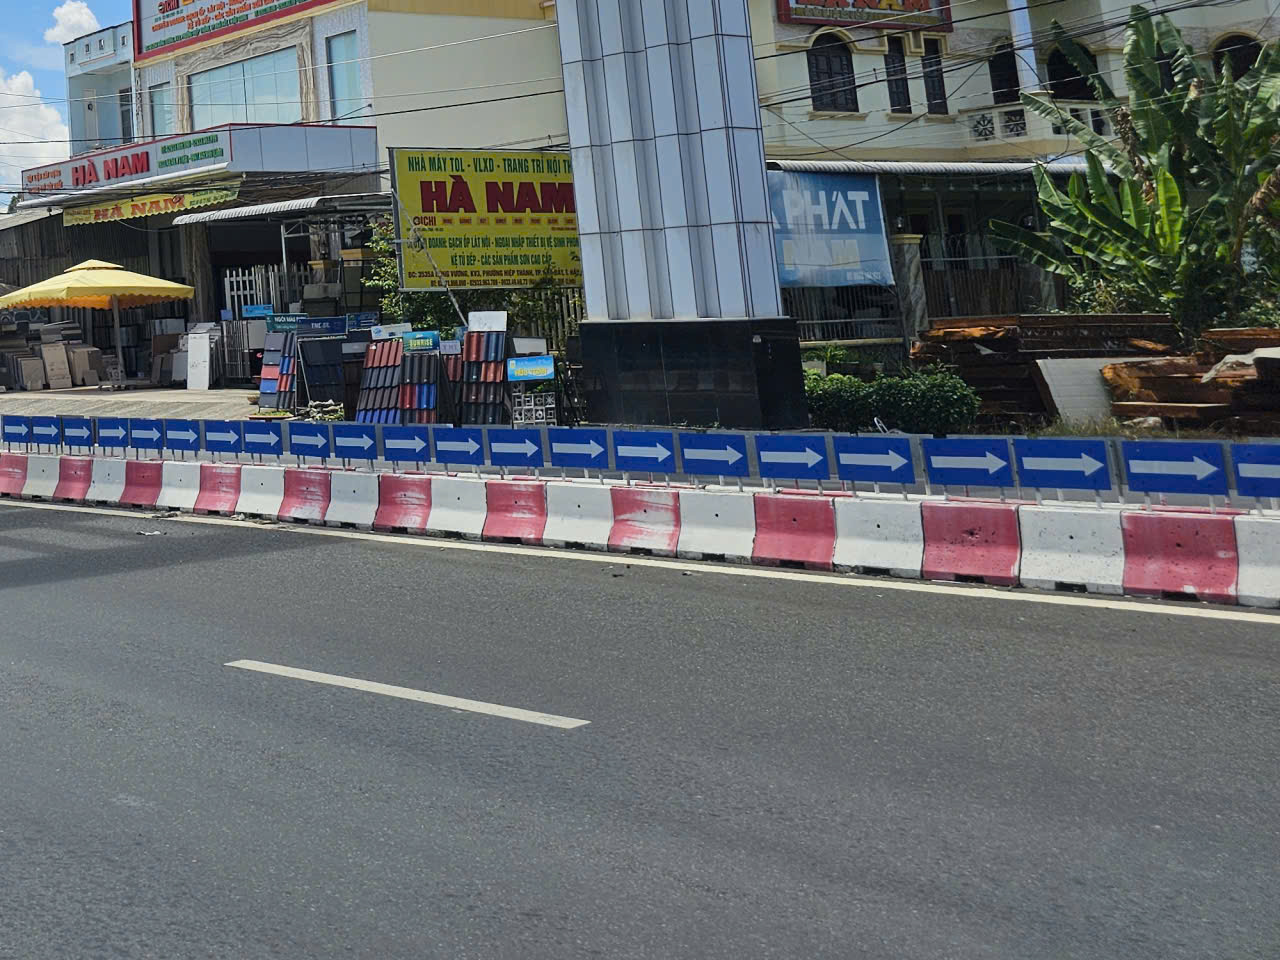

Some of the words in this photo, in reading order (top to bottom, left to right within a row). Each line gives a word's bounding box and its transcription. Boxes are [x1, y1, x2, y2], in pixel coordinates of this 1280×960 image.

[71, 159, 99, 187] HÀ
[103, 151, 150, 181] NAM
[408, 153, 426, 172] NHÀ
[428, 153, 447, 172] MÁY
[449, 157, 465, 172] TOL
[473, 157, 494, 173] VLXD
[503, 157, 529, 174] TRANG
[532, 155, 544, 174] TRÍ
[546, 156, 561, 177] NỘI
[93, 204, 124, 222] HÀ
[131, 194, 185, 217] NAM
[420, 174, 478, 213] HÀ
[485, 182, 576, 213] NAM
[782, 191, 870, 230] PHÁT
